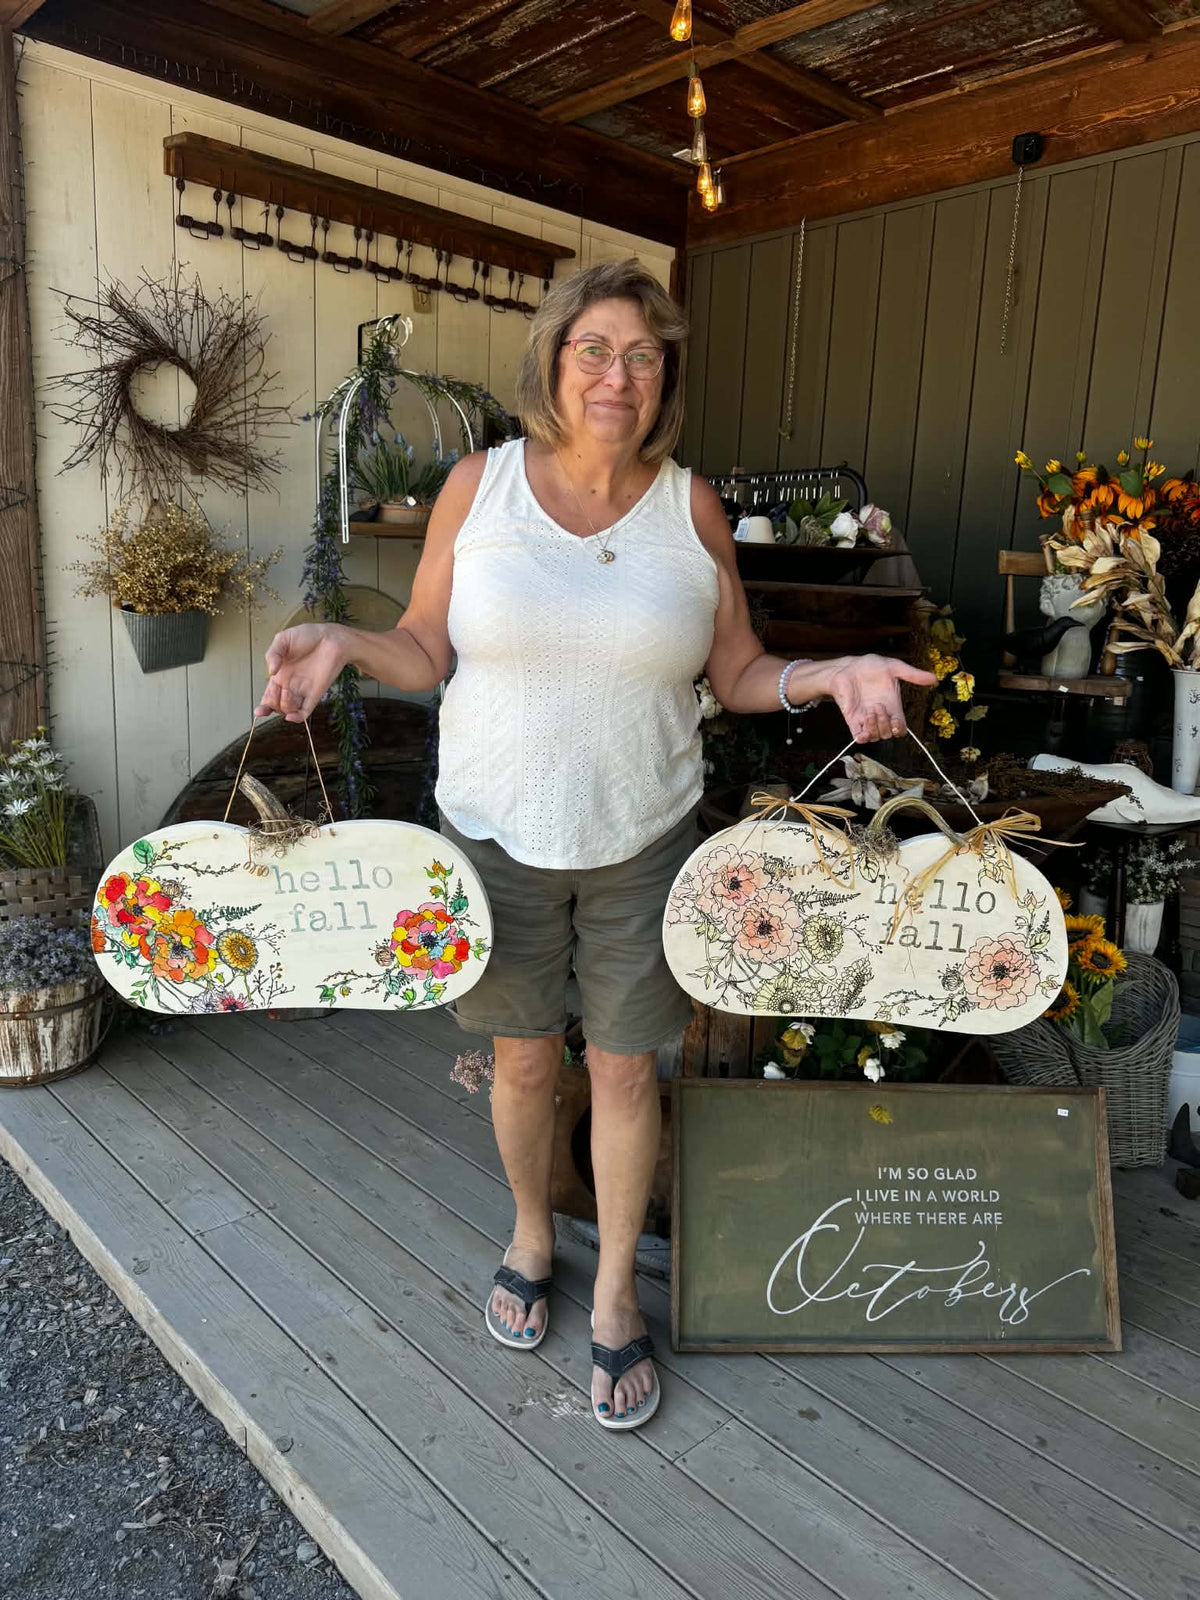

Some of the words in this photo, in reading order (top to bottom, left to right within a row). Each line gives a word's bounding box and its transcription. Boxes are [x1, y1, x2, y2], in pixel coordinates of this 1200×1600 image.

[270, 859, 393, 895] hello
[288, 900, 378, 933] fall
[878, 915, 967, 953] fall
[877, 1166, 902, 1181] I'M
[907, 1167, 929, 1181] SO
[933, 1167, 977, 1181] GLAD
[865, 1189, 900, 1202] LIVE
[904, 1189, 921, 1202] IN
[926, 1189, 938, 1203] A
[941, 1189, 1001, 1203] WORLD
[854, 1211, 912, 1225] WHERE
[916, 1211, 968, 1225] THERE
[972, 1211, 1003, 1225] ARE
[766, 1197, 1091, 1325] Octobers
